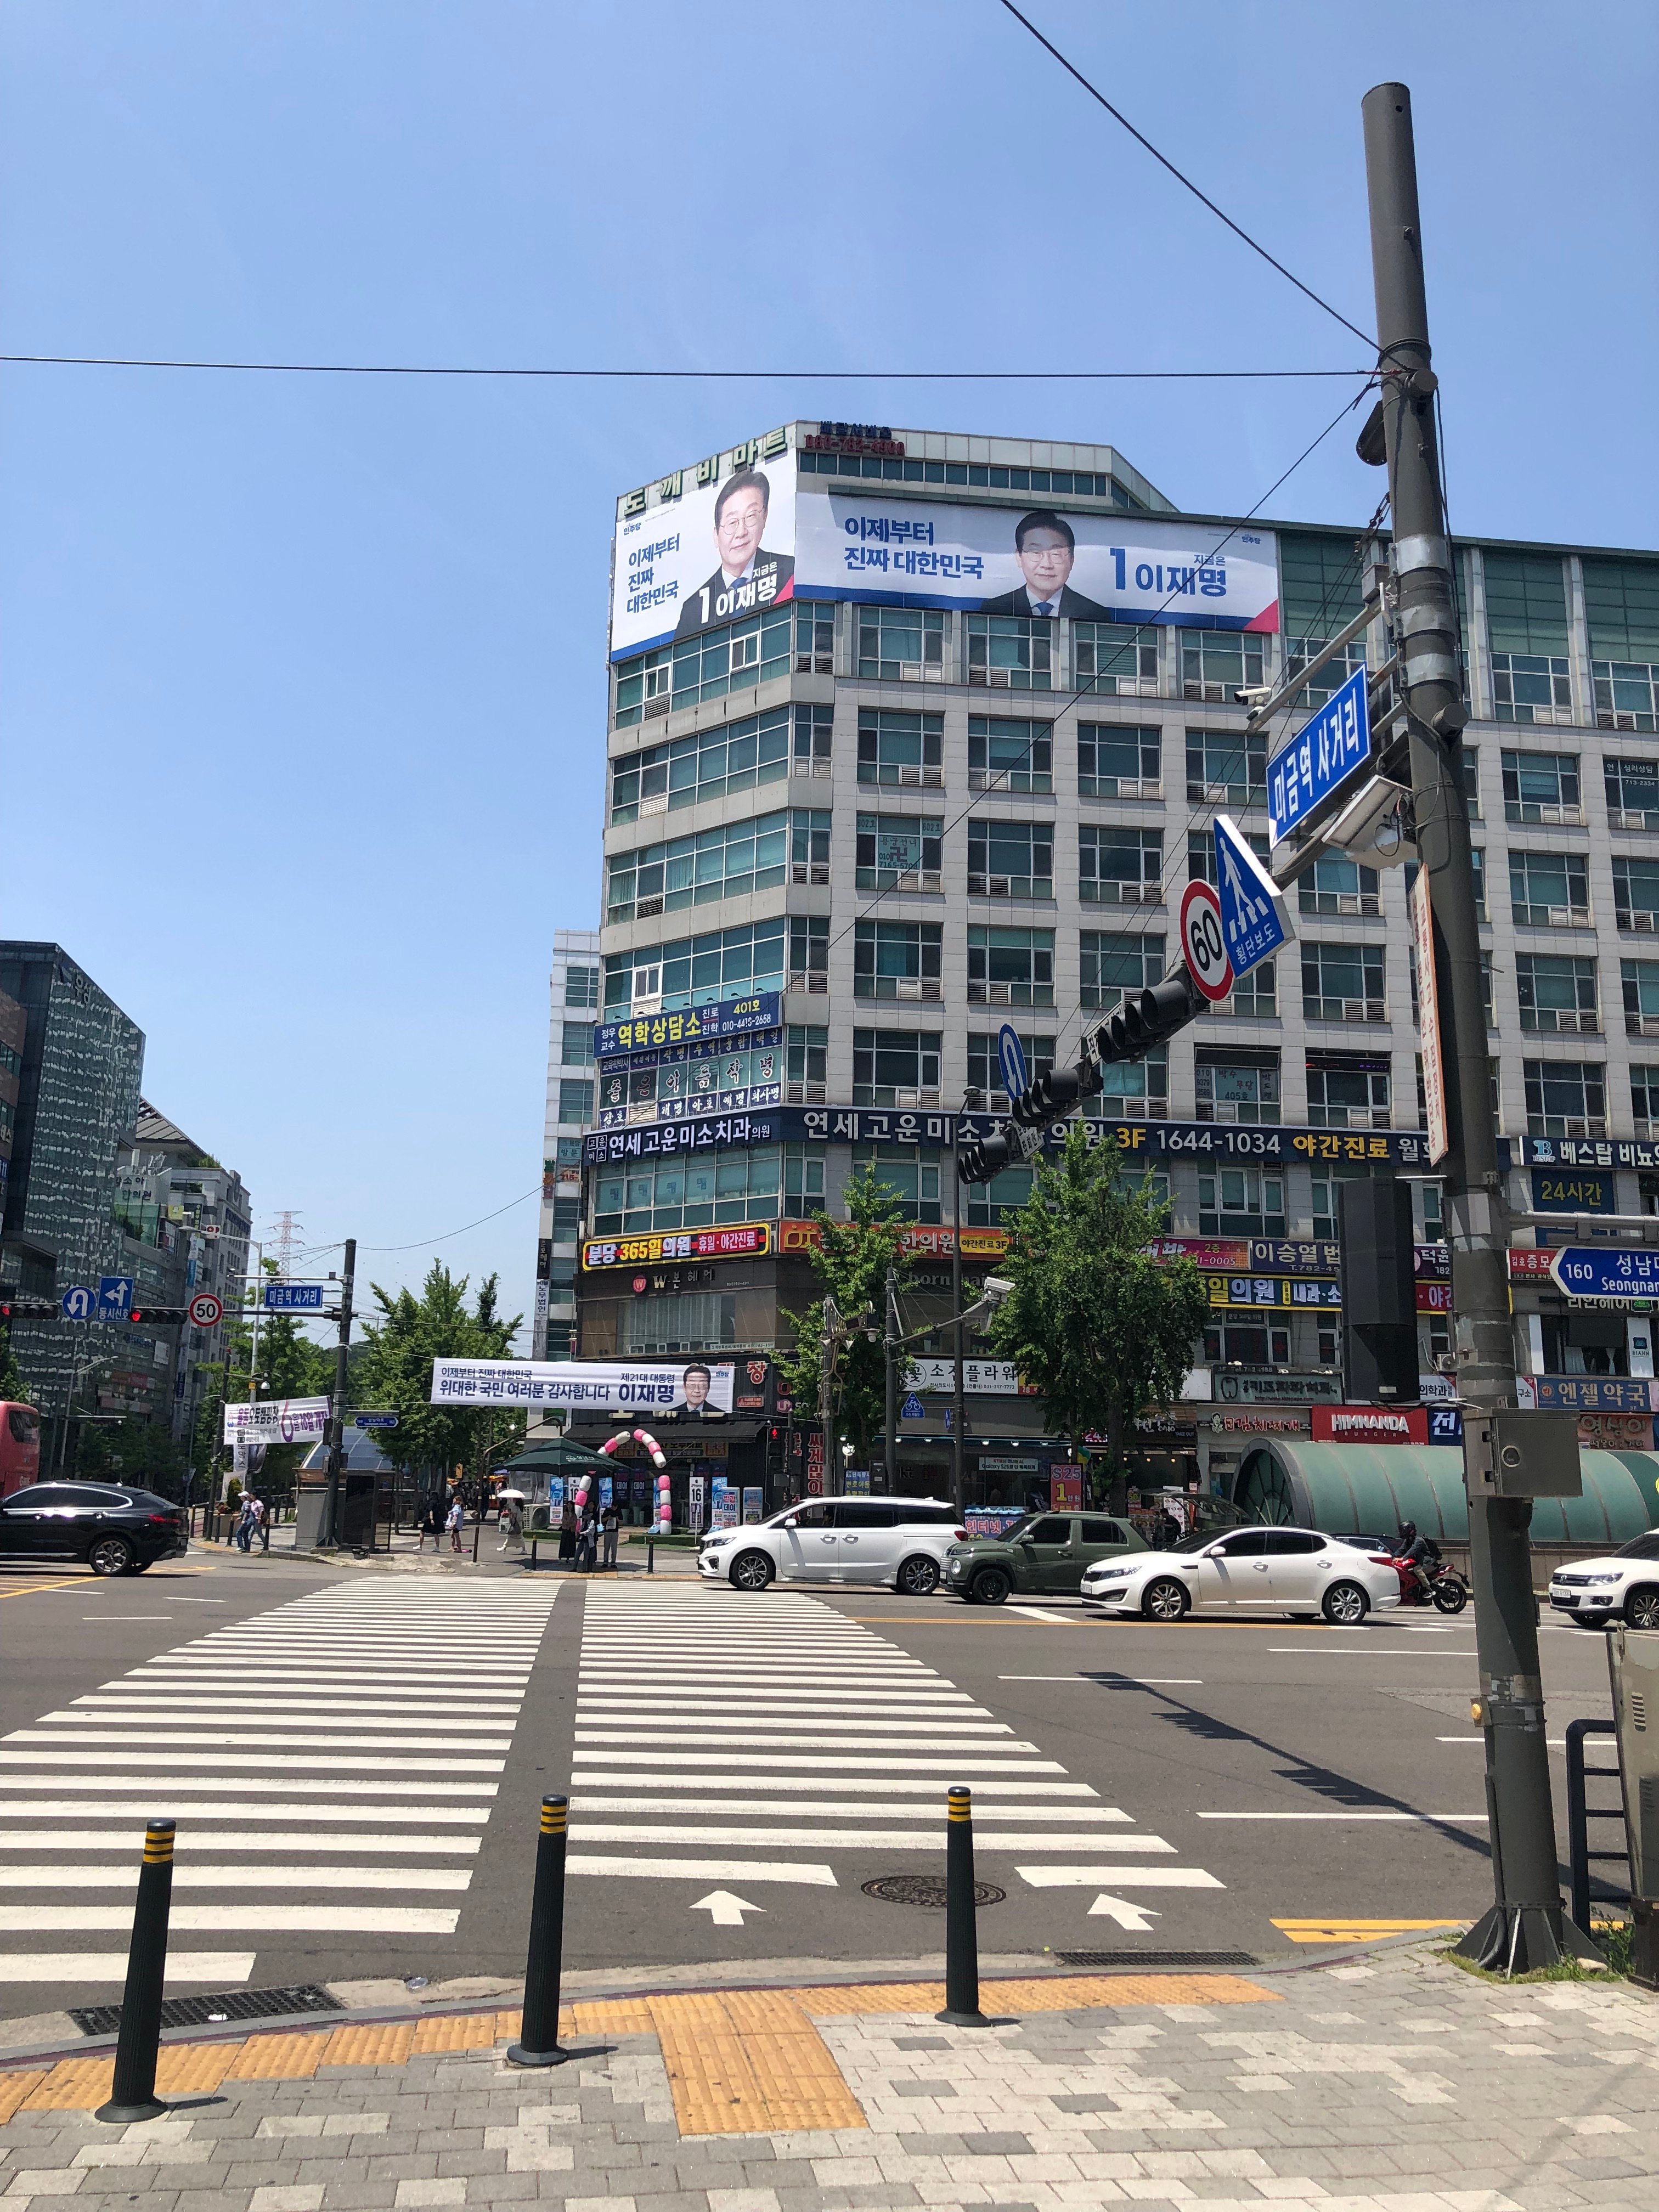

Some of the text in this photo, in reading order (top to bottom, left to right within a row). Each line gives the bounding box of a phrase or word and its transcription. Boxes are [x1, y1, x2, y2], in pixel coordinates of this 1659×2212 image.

[623, 426, 787, 516] 도깨비마트
[844, 517, 934, 546] 이제부터
[629, 533, 680, 568] 이제부터
[844, 547, 984, 580] 진짜 대한민국
[1193, 554, 1226, 567] 지금은
[752, 561, 777, 580] 지금은
[1109, 548, 1227, 598] 1 이재명
[629, 568, 654, 593] 진짜
[627, 580, 679, 614] 대한민국
[699, 573, 777, 624] 1 이재명
[1274, 687, 1358, 823] 미금역 사거리
[880, 836, 917, 847] 용궁선녀
[1190, 909, 1222, 972] 60
[1235, 923, 1276, 966] 횡단보도
[702, 1007, 718, 1019] 진로
[733, 999, 760, 1015] 401호
[601, 1028, 616, 1039] 정우
[618, 1009, 701, 1048] 역학상담소
[702, 1023, 718, 1036] 진학
[600, 1041, 616, 1051] 교수
[751, 1086, 780, 1102] 회사명
[1225, 1091, 1249, 1101] 405호
[1117, 1128, 1146, 1149] 3F
[1156, 1130, 1281, 1154] 1644-1034
[1293, 1135, 1390, 1159] 야간진료
[1560, 1142, 1613, 1165] 베스탑
[1541, 1181, 1602, 1206] 24시간
[962, 1239, 1007, 1250] 야간진료 3F
[1204, 1244, 1221, 1254] 2층
[1255, 1243, 1318, 1263] 이승열
[588, 1244, 616, 1265] 분당
[1566, 1264, 1593, 1279] 160
[1616, 1255, 1659, 1276] 성남
[687, 1269, 713, 1282] 헤어
[908, 1271, 951, 1285] born
[269, 1289, 317, 1305] 미금역 사거리
[99, 1307, 129, 1321] 동시신호
[196, 1304, 216, 1318] 50
[441, 1367, 532, 1380] 이제부터 진짜 대한민국
[620, 1373, 675, 1384] 제21대 대통령
[439, 1383, 610, 1401] 위대한 국민 여러분 감사합니다
[619, 1384, 674, 1403] 이재명
[1558, 1383, 1645, 1406] 엔젤약국
[1235, 1414, 1300, 1432] 김치찌개
[1331, 1414, 1409, 1434] HIMNANDA
[1580, 1415, 1646, 1436] 영심이
[1052, 1467, 1081, 1480] S25
[692, 1488, 701, 1502] 16
[965, 1520, 1002, 1534] 인터넷
